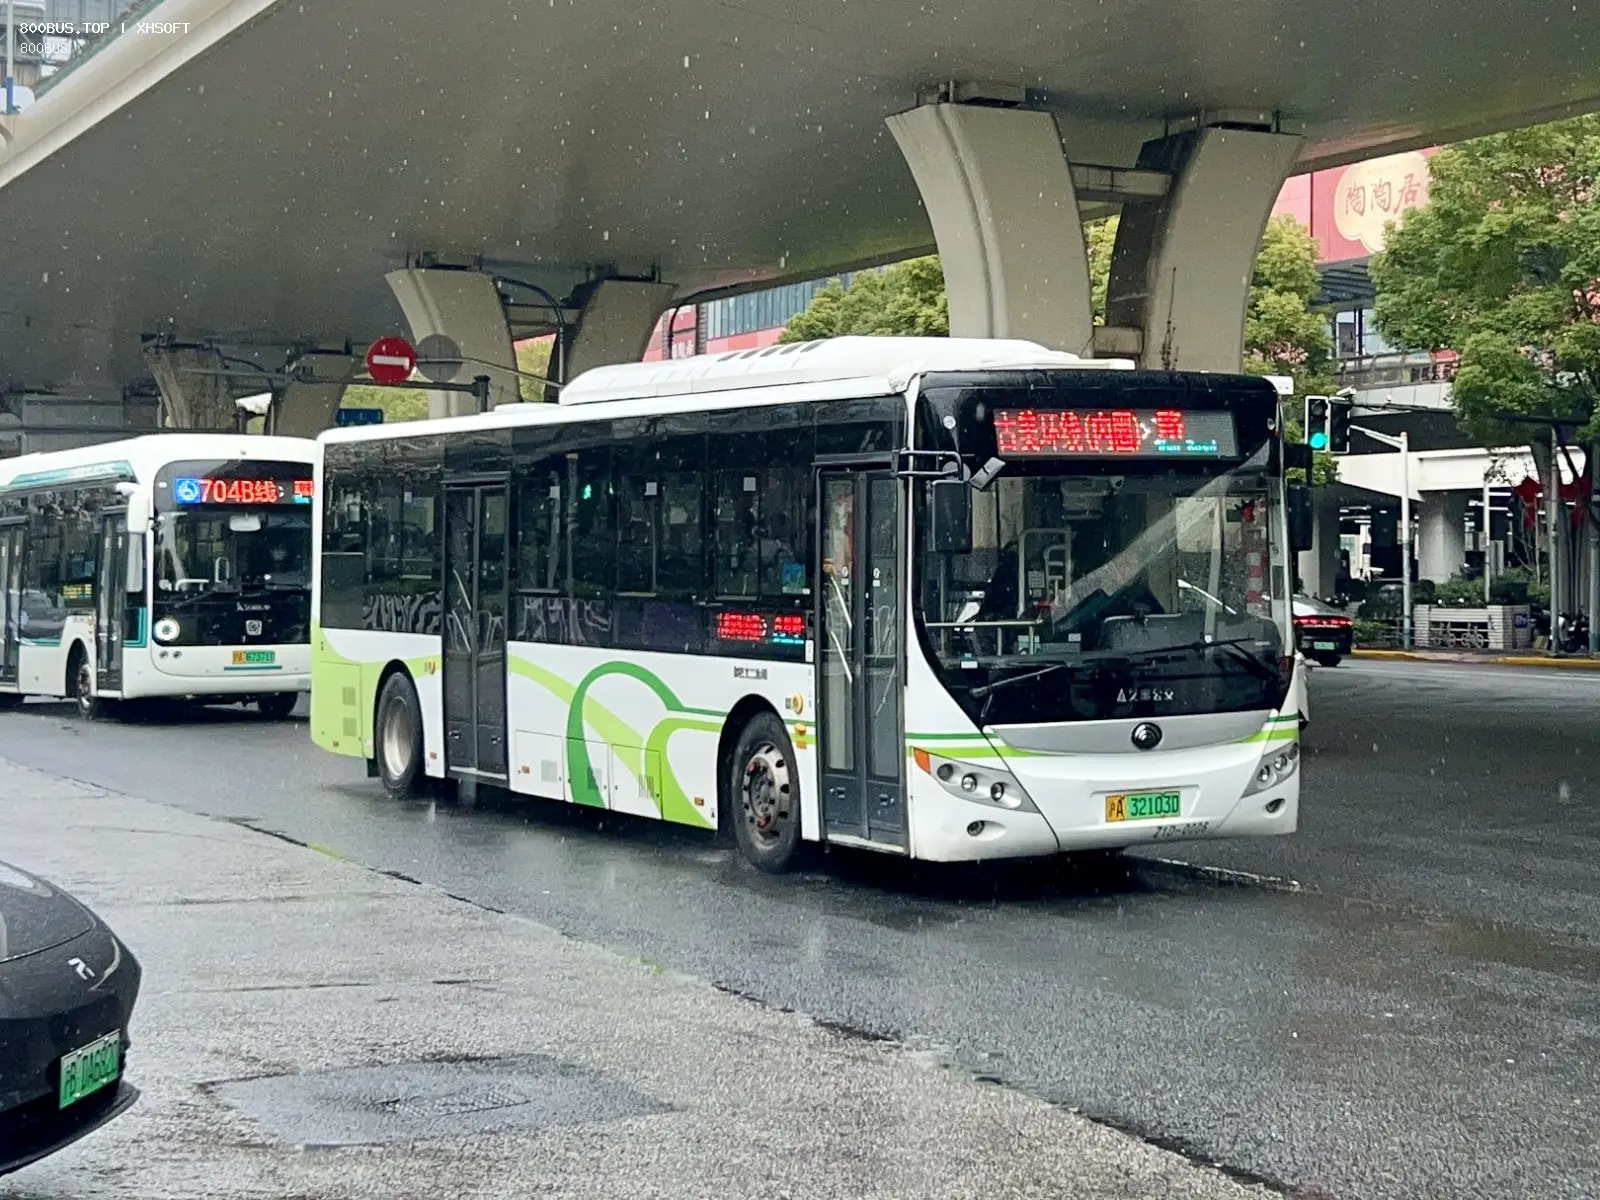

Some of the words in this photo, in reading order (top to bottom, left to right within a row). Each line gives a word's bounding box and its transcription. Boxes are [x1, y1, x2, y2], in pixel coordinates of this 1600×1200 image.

[1345, 173, 1421, 217] 陶陶居
[200, 479, 278, 503] 704B线
[1130, 795, 1179, 816] 32103D
